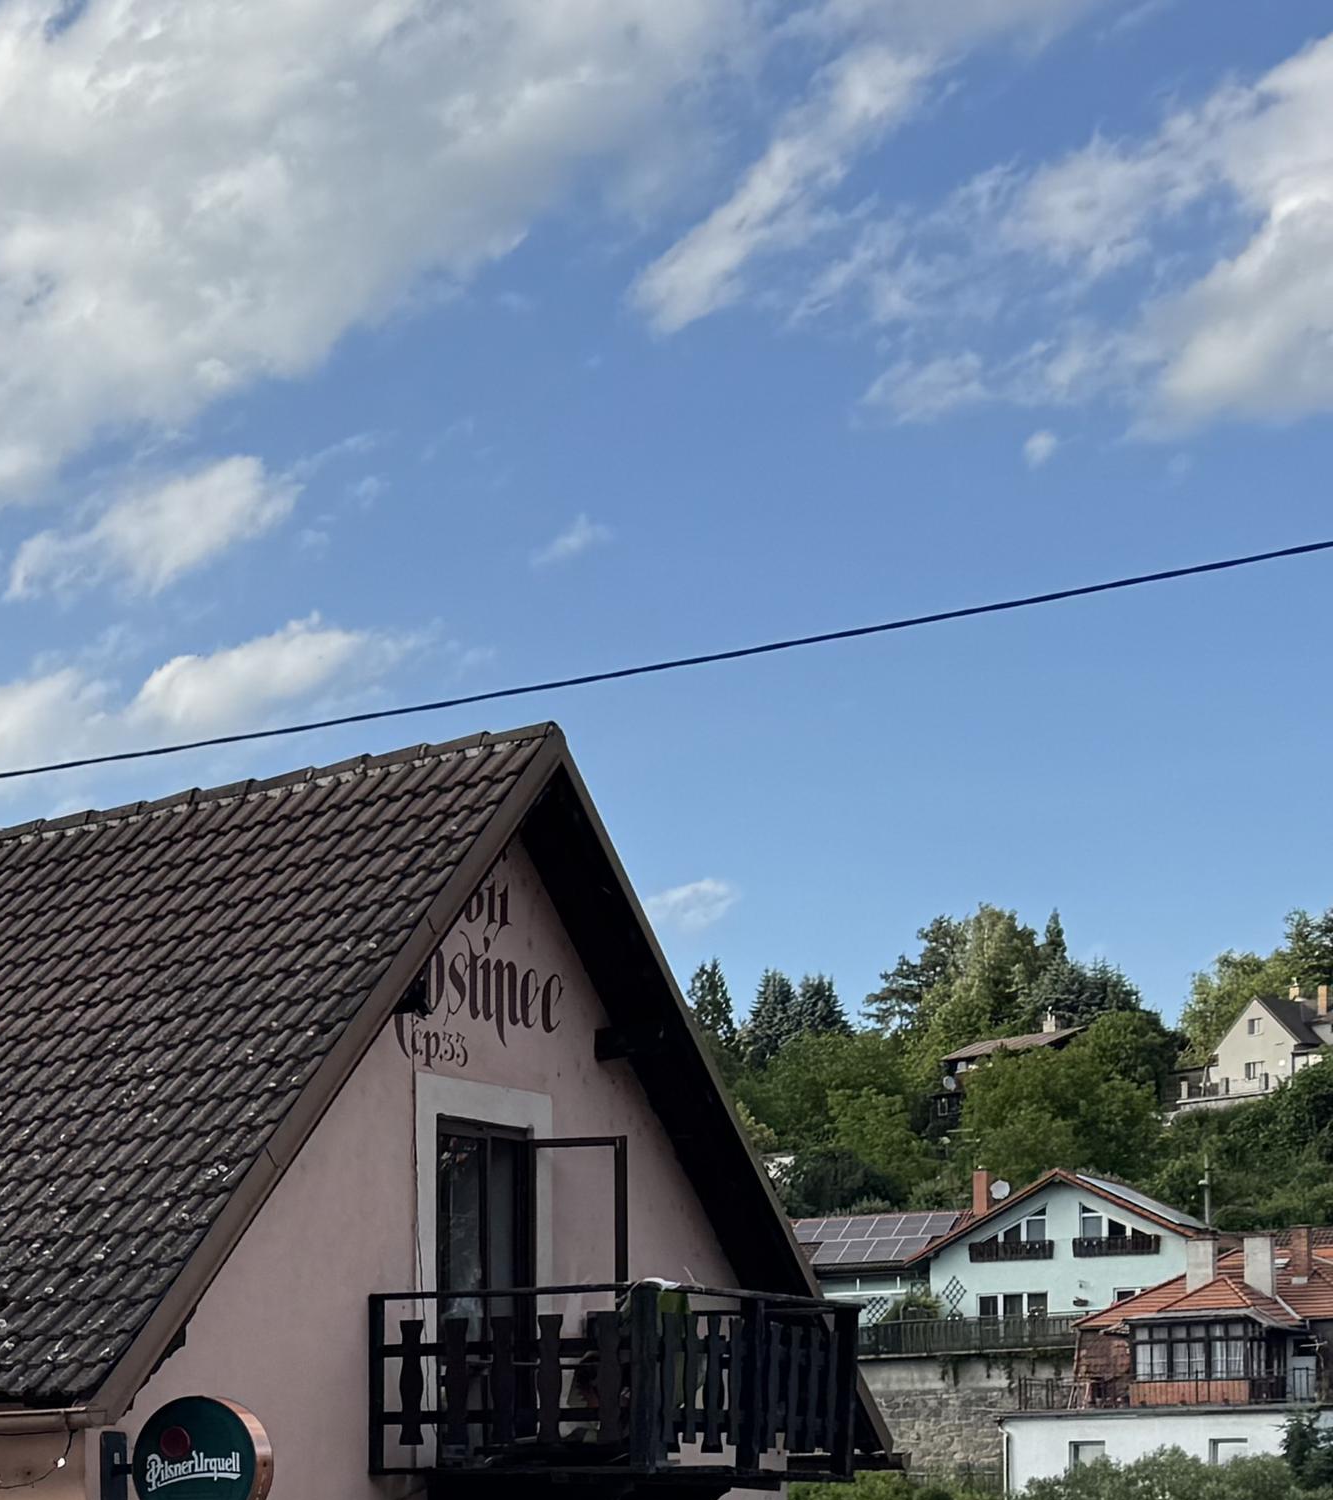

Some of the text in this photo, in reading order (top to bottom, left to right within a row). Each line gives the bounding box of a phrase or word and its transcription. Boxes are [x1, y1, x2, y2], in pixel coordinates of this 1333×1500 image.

[394, 930, 564, 1059] ostinec
[145, 1450, 241, 1492] Pilsner Urquell
